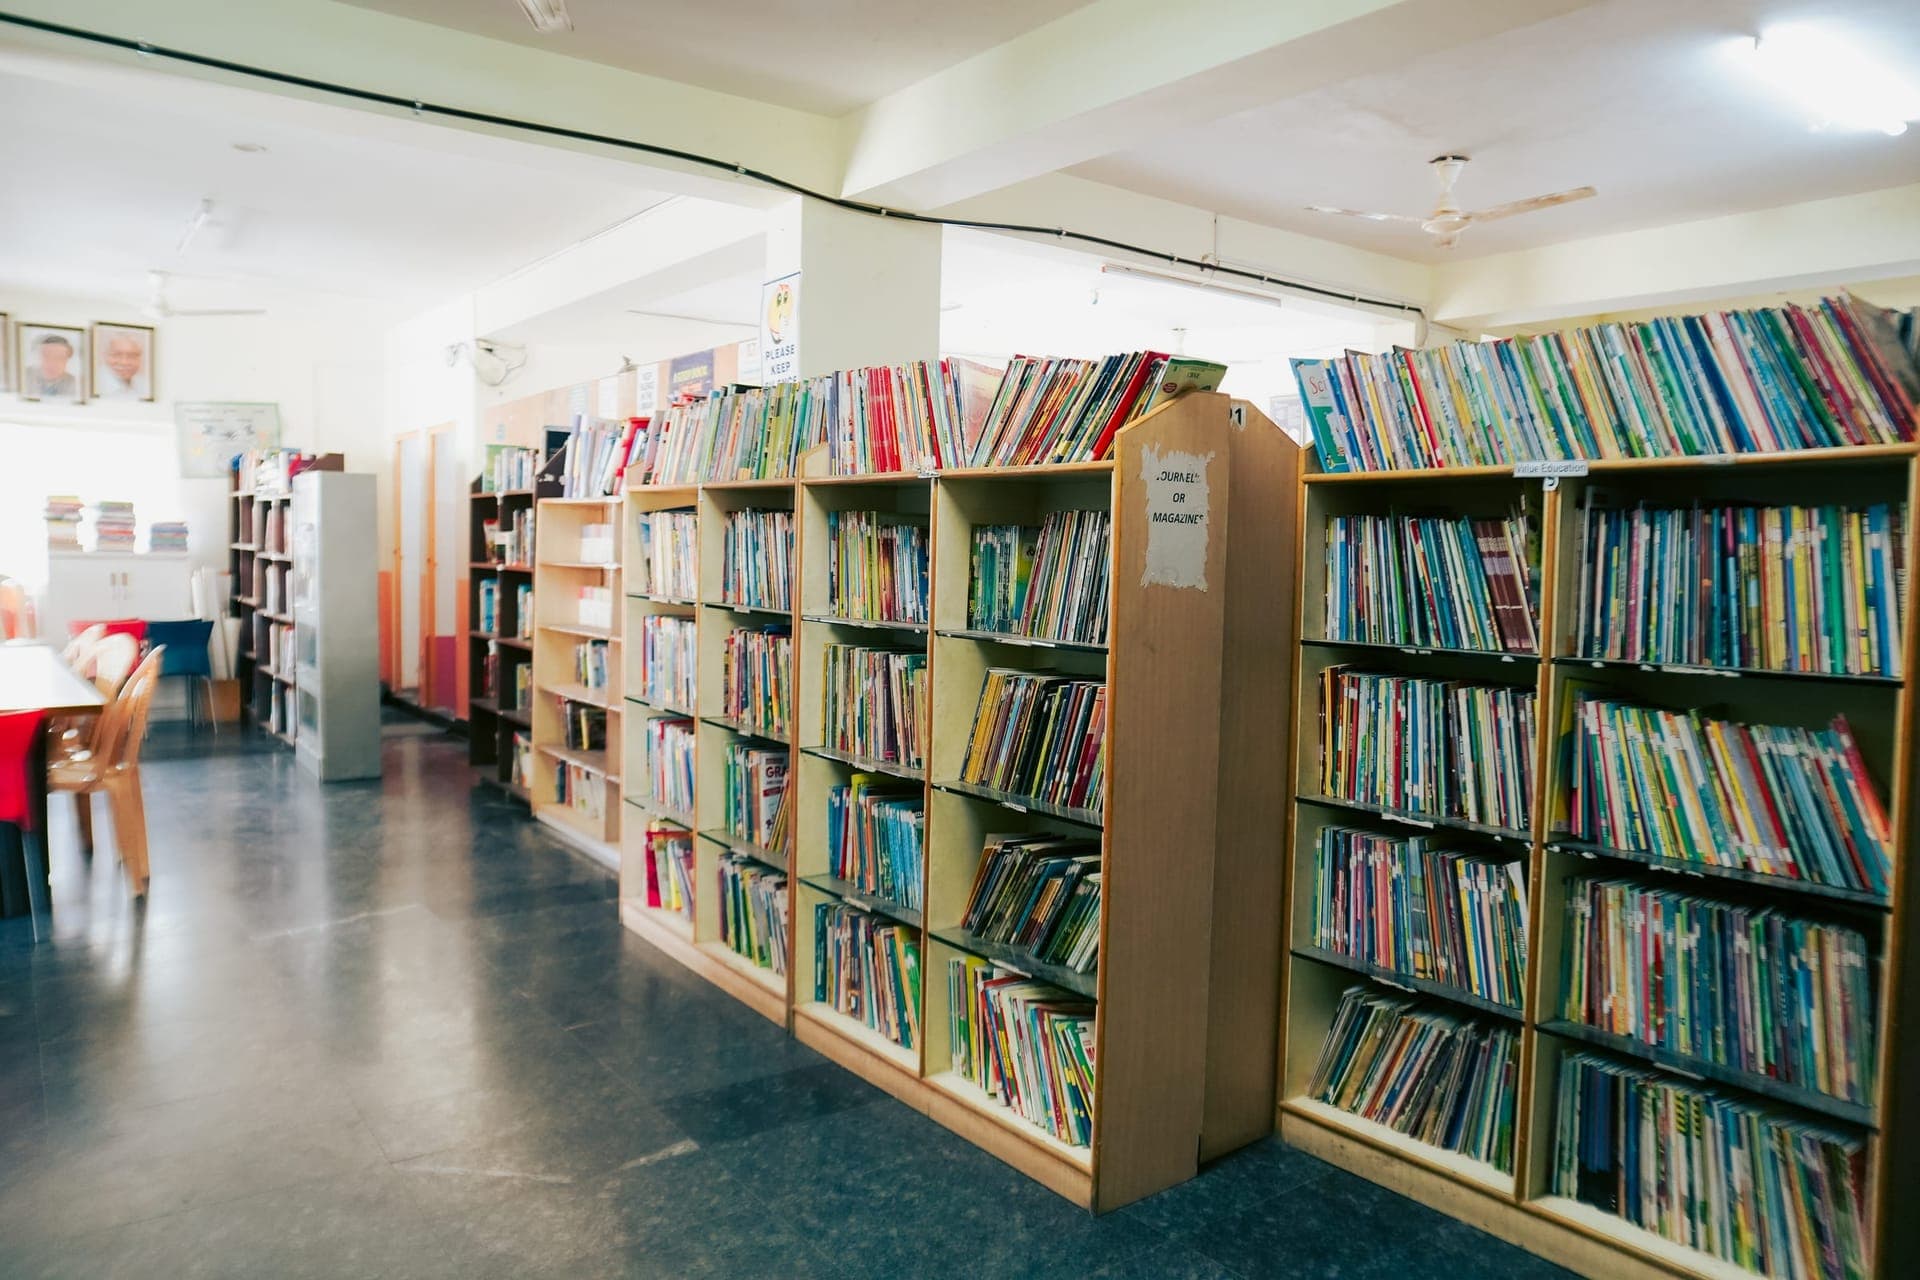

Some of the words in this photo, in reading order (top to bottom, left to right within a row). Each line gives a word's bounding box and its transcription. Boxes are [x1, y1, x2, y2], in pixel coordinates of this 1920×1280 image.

[766, 344, 795, 360] PLEASE
[771, 361, 790, 375] KEEP
[1541, 463, 1586, 473] Education
[1172, 492, 1185, 503] OR
